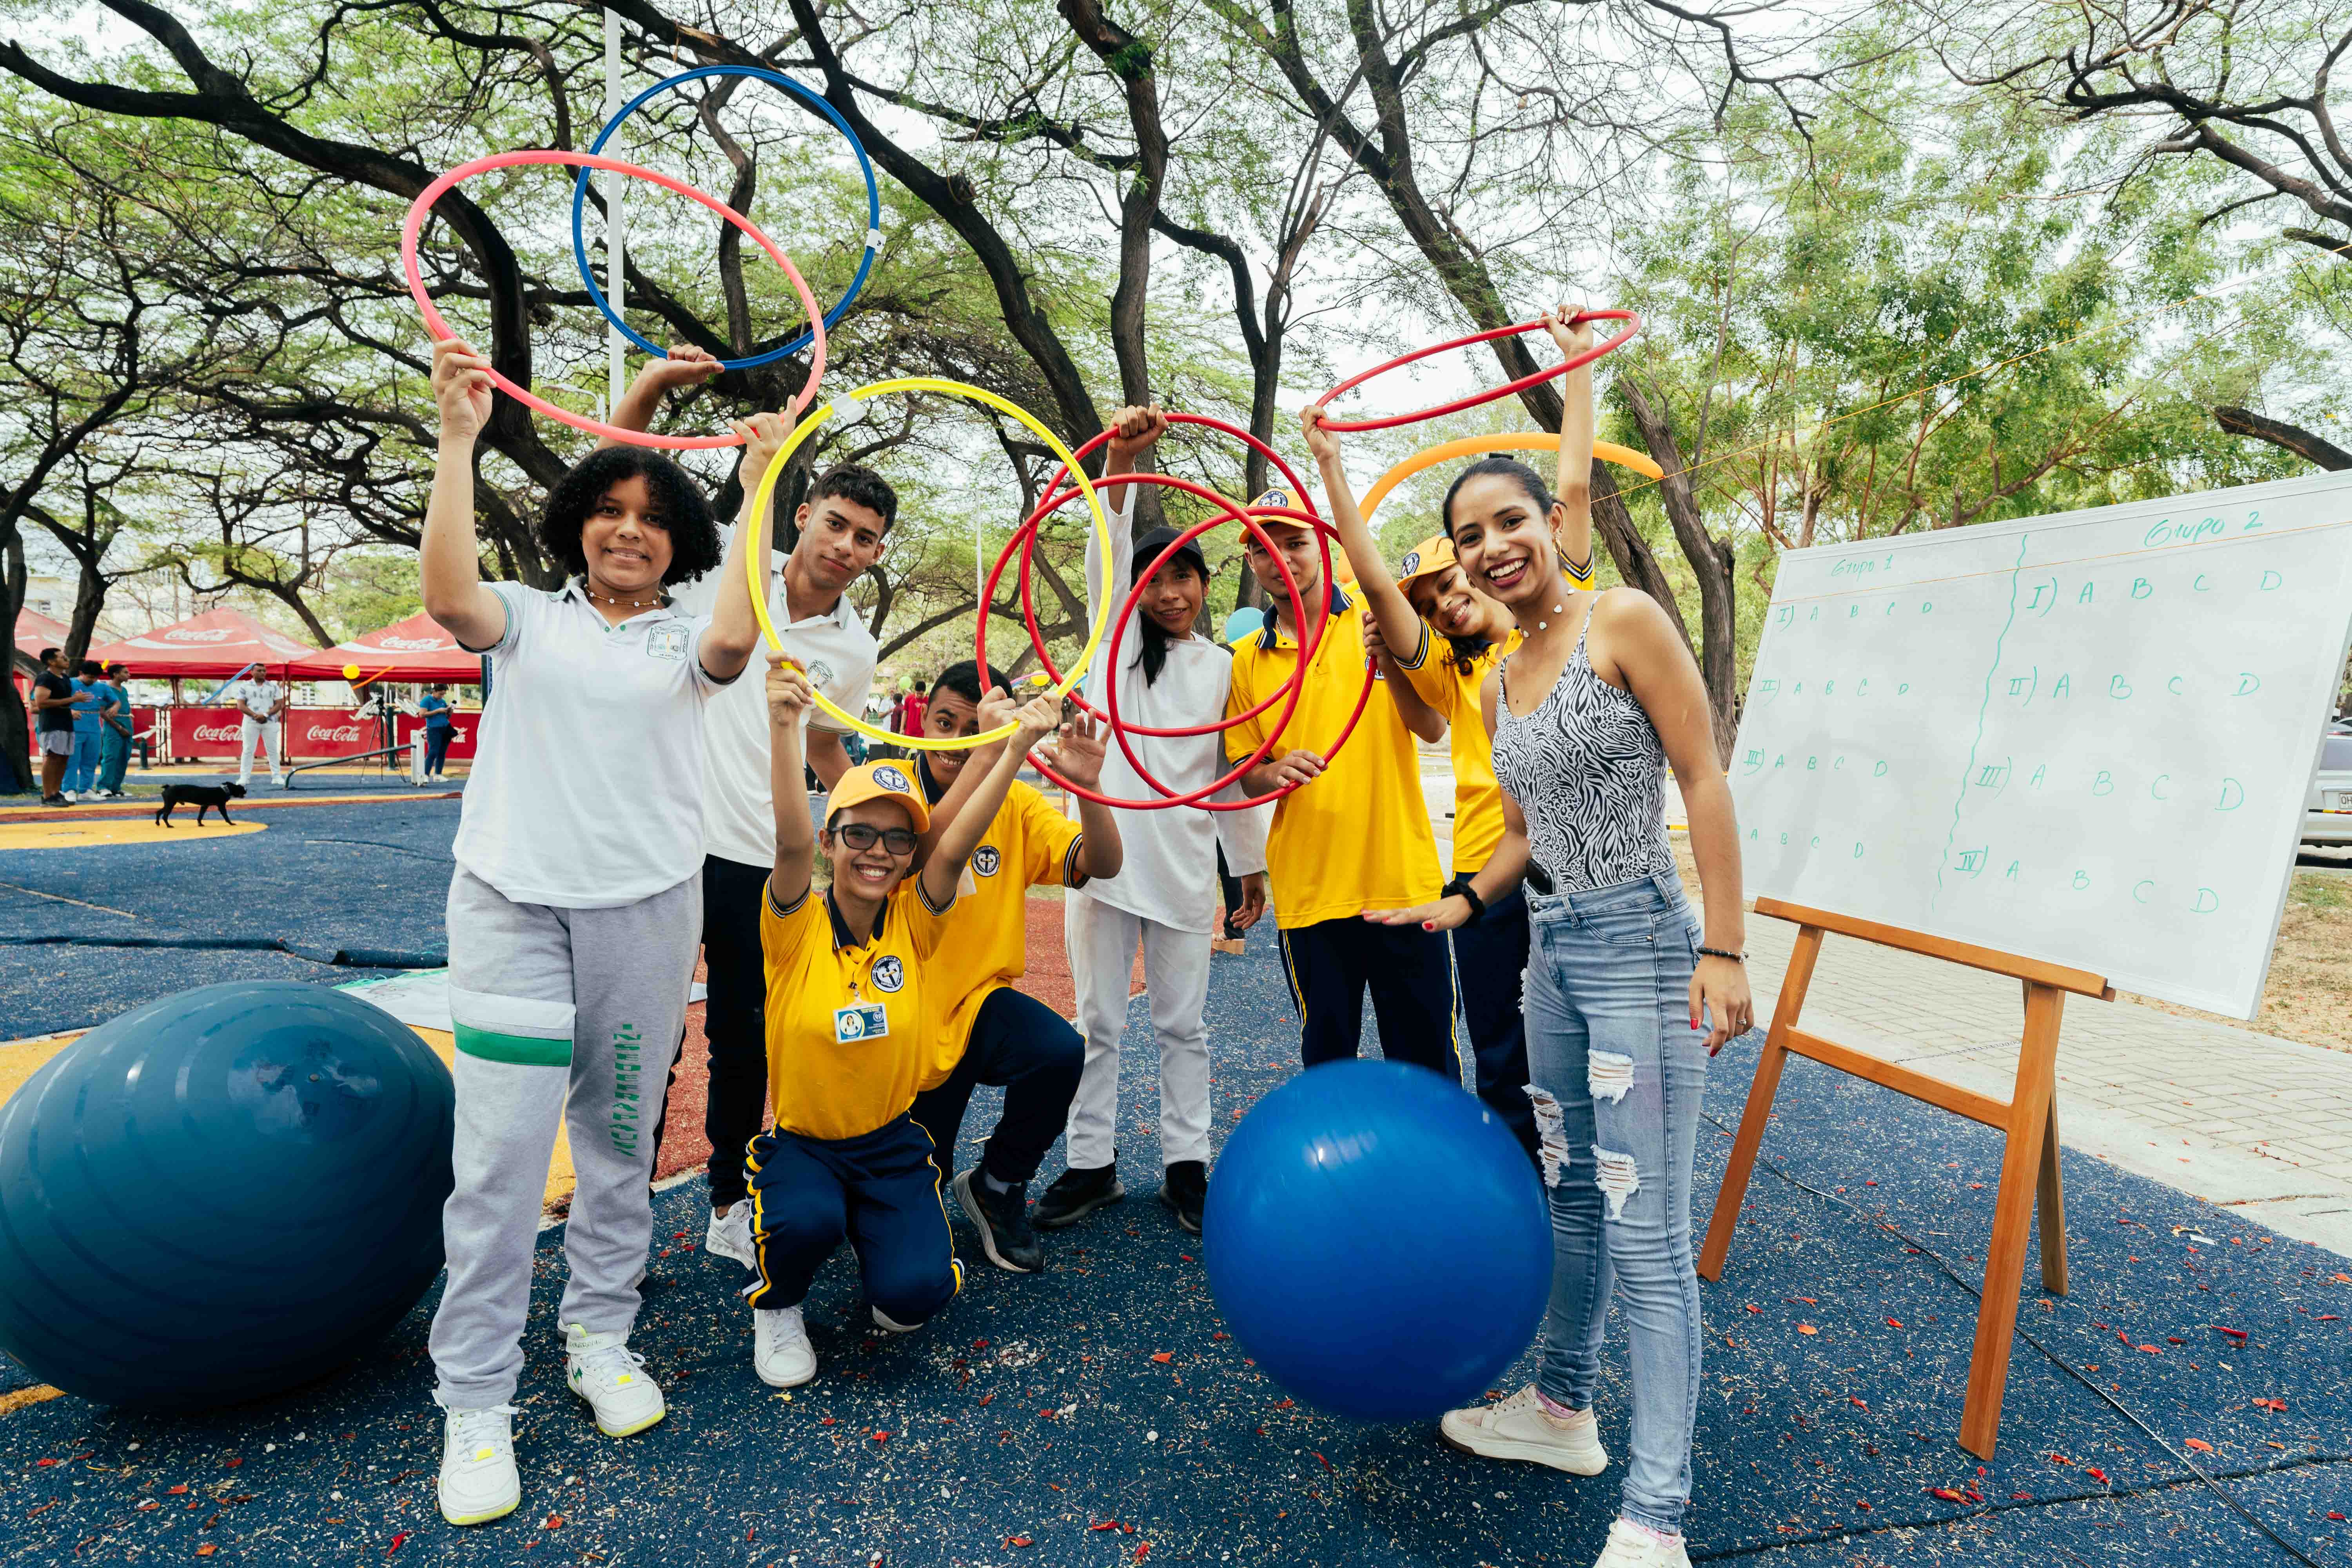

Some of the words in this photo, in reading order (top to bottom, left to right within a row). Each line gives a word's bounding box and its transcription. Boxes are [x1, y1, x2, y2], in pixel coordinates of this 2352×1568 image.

[2144, 517, 2225, 547] Grupo
[2244, 512, 2263, 530] 2
[1831, 559, 1875, 582] Grupo
[1884, 555, 1893, 570] 1
[2026, 577, 2058, 617] I)
[2079, 582, 2094, 604] A
[2131, 577, 2154, 599] B
[2194, 574, 2210, 591] C
[2260, 571, 2282, 590] D
[1777, 605, 1794, 632] I)
[1810, 606, 1819, 621] A
[1850, 605, 1858, 618] B
[1887, 602, 1895, 615] C
[1921, 602, 1932, 615] D
[1759, 679, 1781, 706] II)
[1794, 682, 1802, 694] A
[1825, 681, 1835, 694] B
[1857, 679, 1867, 696] C
[1898, 684, 1909, 695] D
[2008, 666, 2037, 706] II)
[2053, 673, 2070, 699] A
[2110, 675, 2133, 700] B
[2168, 677, 2183, 695] C
[2230, 673, 2261, 696] D
[307, 725, 361, 742] Coca-Cola
[1743, 748, 1764, 776] III)
[1775, 754, 1785, 768] A
[1806, 756, 1817, 770] B
[1834, 756, 1844, 769] C
[1872, 760, 1888, 777] D
[1975, 757, 2012, 800] III)
[2031, 764, 2045, 789] A
[2092, 771, 2114, 796] B
[2152, 775, 2170, 800] C
[2214, 778, 2244, 811] D
[1751, 828, 1759, 840] A
[1780, 833, 1788, 845] B
[1811, 836, 1820, 848] C
[1854, 842, 1863, 859] D
[1954, 845, 1988, 880] IV)
[2007, 860, 2020, 881] A
[2073, 870, 2090, 890] B
[2133, 880, 2154, 904] C
[2190, 888, 2219, 913] D
